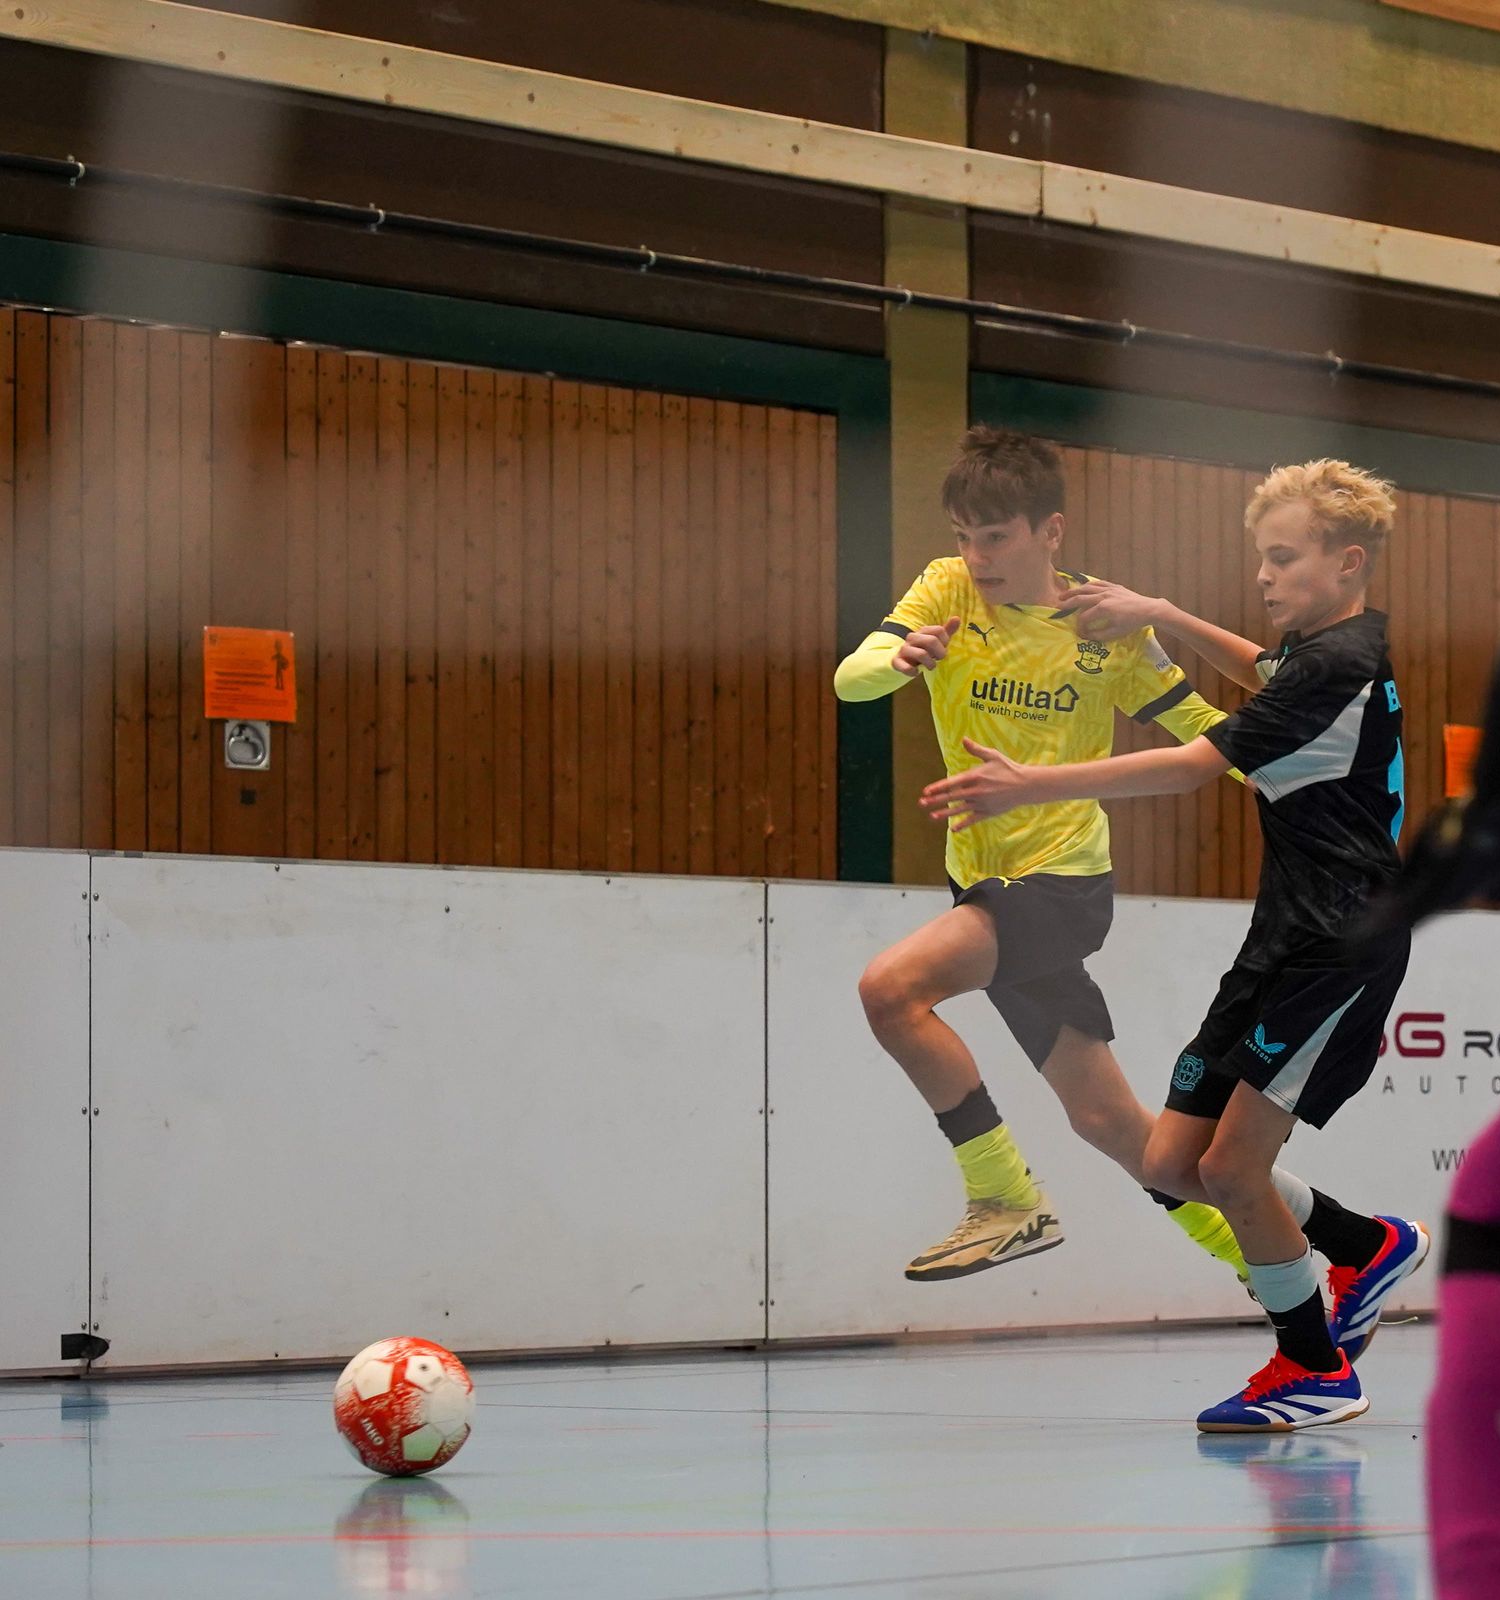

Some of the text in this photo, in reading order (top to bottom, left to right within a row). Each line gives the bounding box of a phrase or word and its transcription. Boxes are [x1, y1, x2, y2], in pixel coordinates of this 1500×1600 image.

[971, 676, 1051, 710] utilita
[969, 699, 1049, 722] life with power
[1378, 1012, 1446, 1058] G
